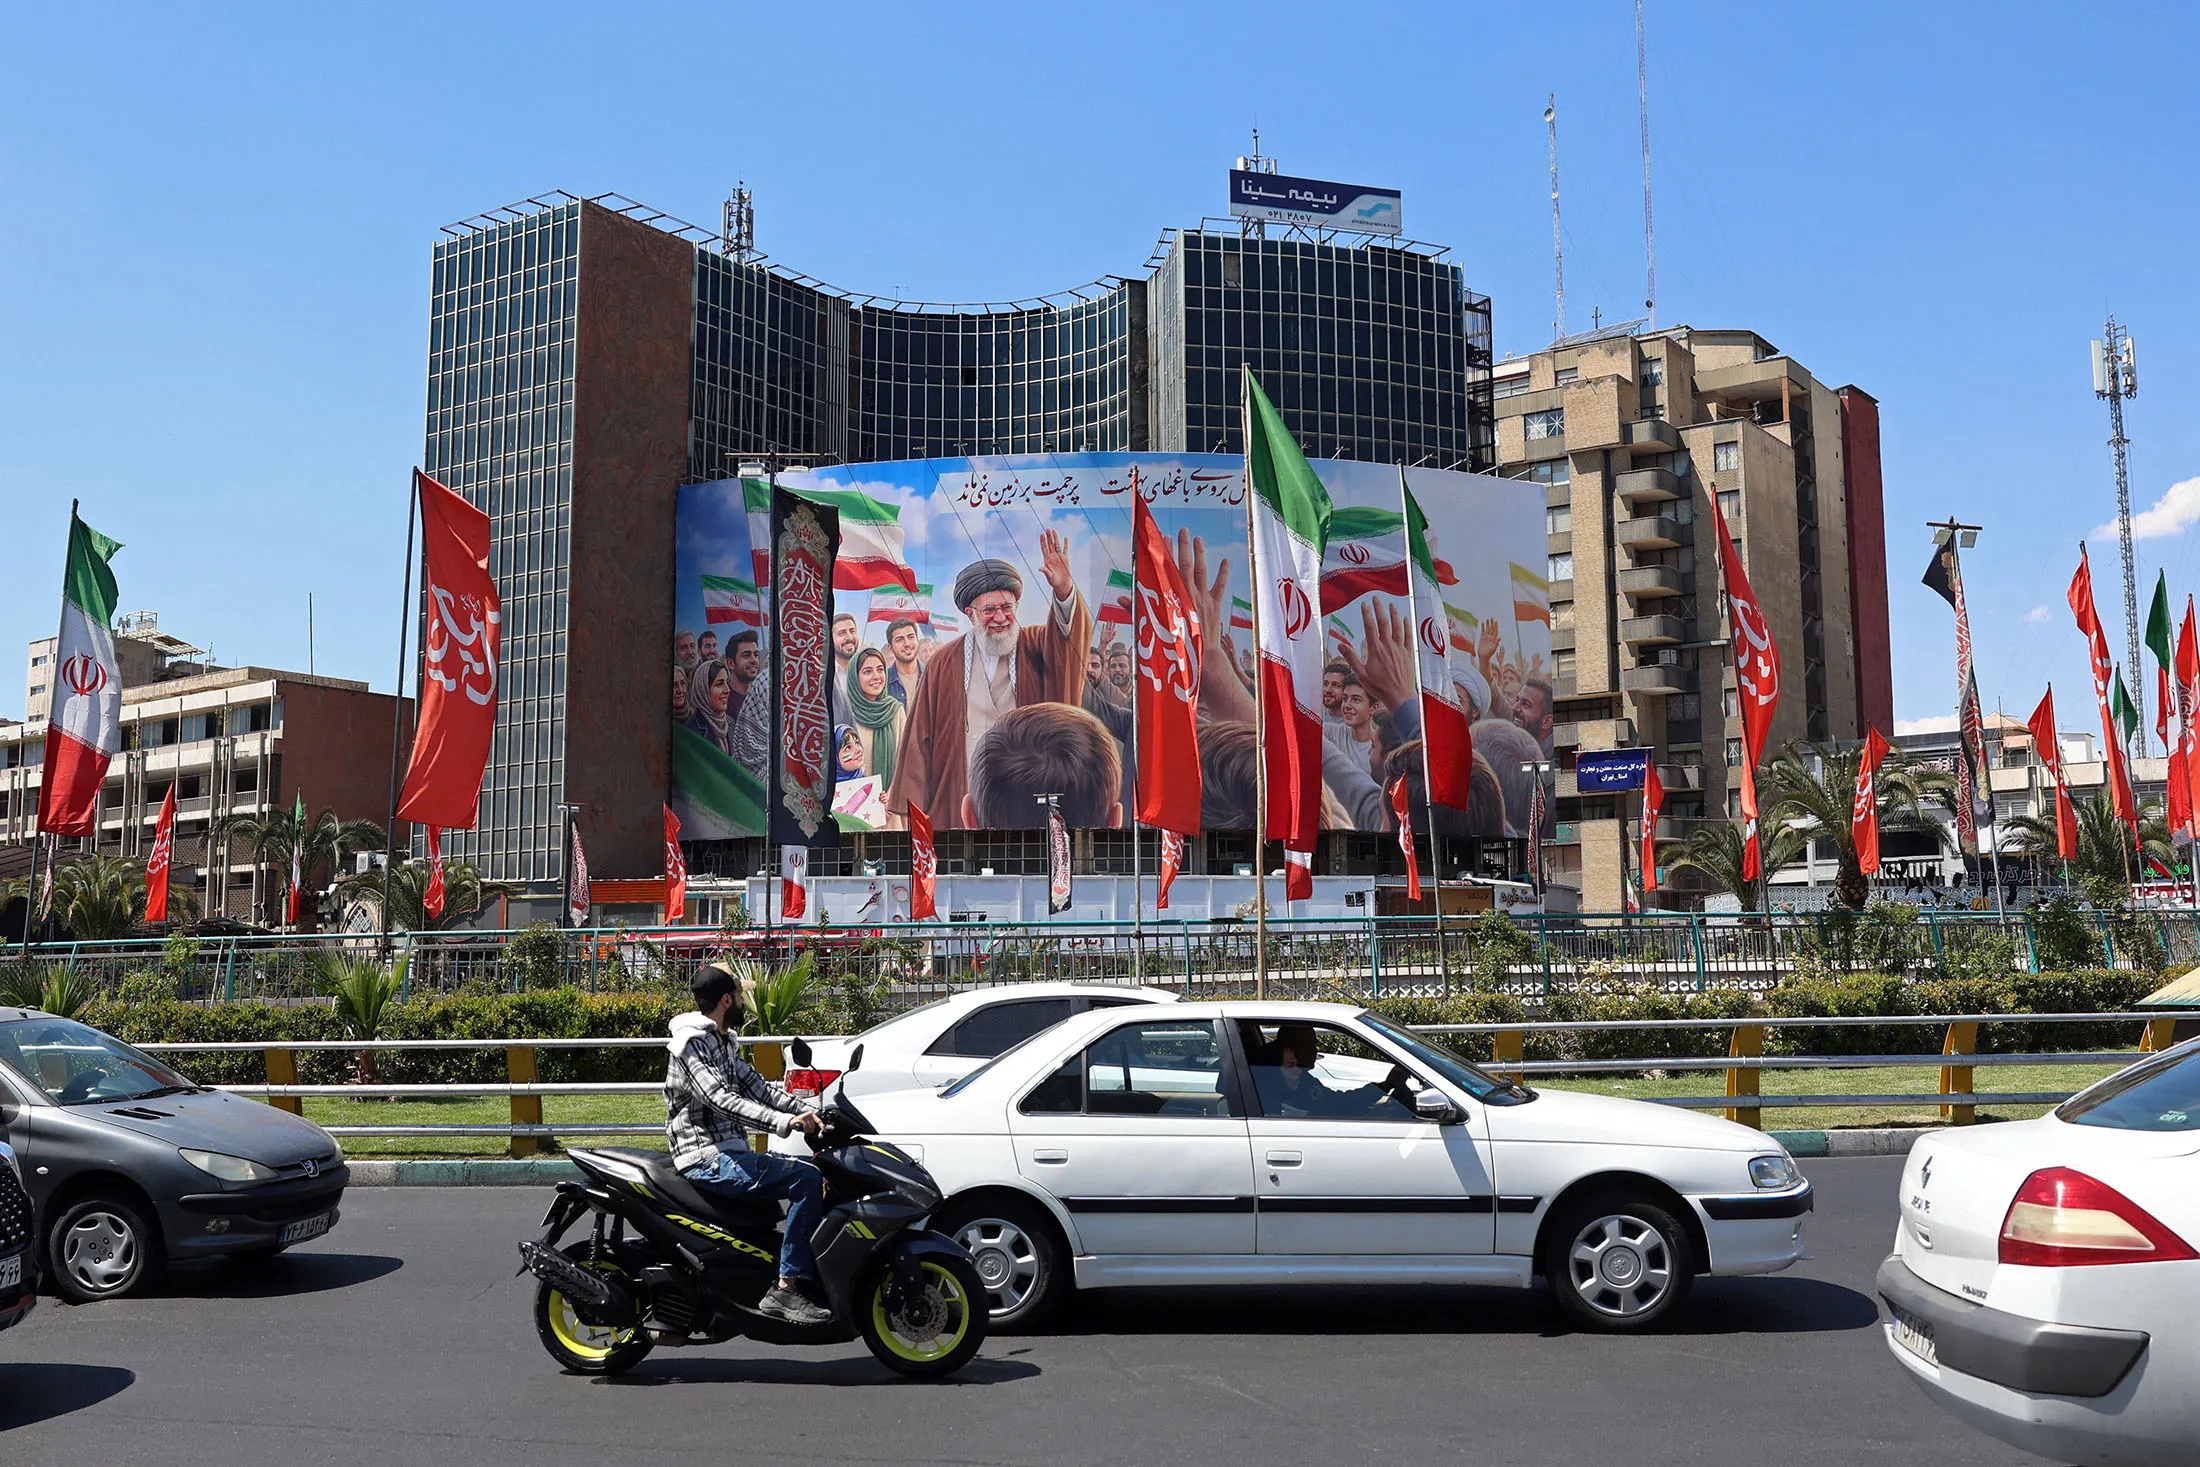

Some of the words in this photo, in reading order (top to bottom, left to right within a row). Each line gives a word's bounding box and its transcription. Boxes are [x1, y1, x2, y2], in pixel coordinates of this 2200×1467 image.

[1241, 179, 1286, 200] سینا
[1289, 189, 1337, 209] بیمه
[1268, 210, 1282, 219] ۰۲۱
[1287, 211, 1312, 222] ۲۸۰۷
[988, 478, 1019, 507] زمین
[1019, 484, 1031, 503] بر
[1033, 476, 1079, 505] پرچمت
[1636, 763, 1647, 771] داره
[1601, 774, 1614, 782] تهران
